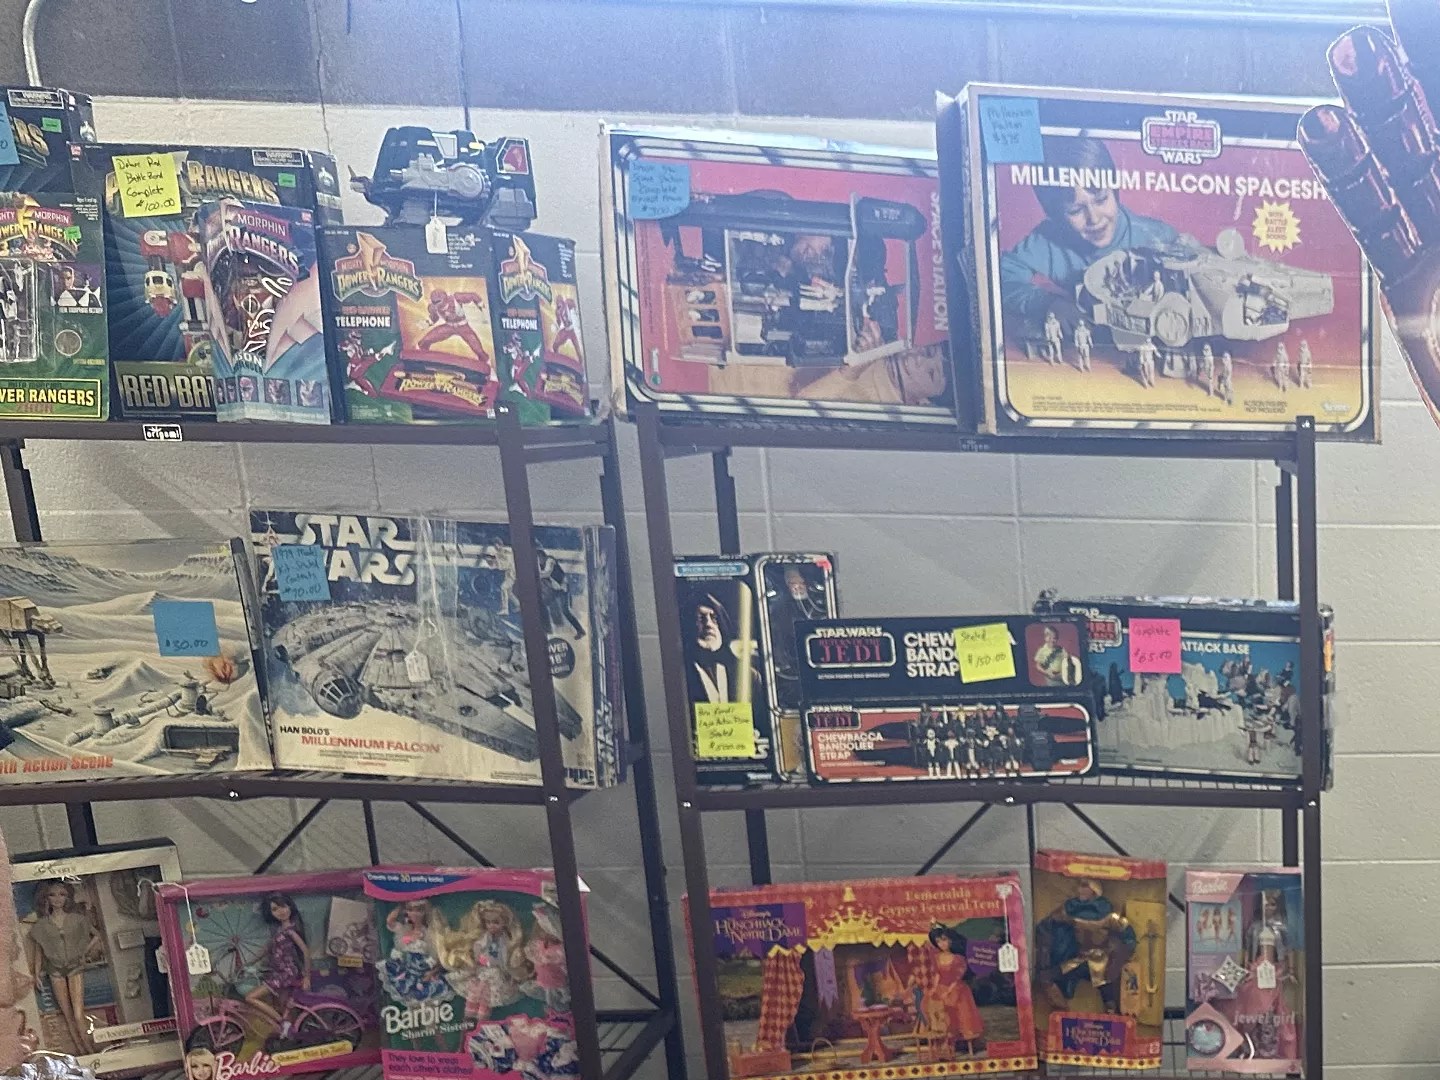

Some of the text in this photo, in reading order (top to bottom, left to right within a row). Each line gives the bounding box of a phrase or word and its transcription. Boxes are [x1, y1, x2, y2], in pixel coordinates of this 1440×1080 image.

[1164, 110, 1199, 123] STAR
[1161, 152, 1203, 165] WARS
[187, 160, 281, 204] RANGERS
[1011, 165, 1140, 191] MILLENNIUM
[1145, 171, 1230, 197] FALCON
[126, 186, 164, 198] Complete
[136, 199, 176, 212] $100.00
[237, 212, 287, 237] MORPHIN
[228, 226, 299, 270] RANGERS
[377, 269, 421, 294] RANGERS
[932, 249, 949, 331] STATION
[335, 316, 391, 328] TELEPHONE
[502, 317, 538, 331] TELEPHONE
[29, 389, 95, 407] RANGERS
[123, 375, 170, 408] RED
[295, 513, 414, 551] STAR
[323, 549, 416, 586] ARS
[816, 627, 882, 637] STAR WARS
[820, 644, 881, 663] JEDI
[1181, 643, 1250, 655] ATTACK BASE
[907, 664, 959, 678] STRAP
[280, 725, 300, 734] HAN
[818, 731, 884, 742] CHEWBACCA
[302, 735, 441, 753] MILLENNIUM FALCON
[818, 741, 875, 752] BANDOLIER
[819, 751, 851, 761] STRAP
[23, 755, 114, 773] Action Scene
[905, 889, 971, 901] Esmeralda
[879, 899, 1001, 918] Gypsy Festival Tent
[381, 1001, 454, 1034] Barbie
[1233, 1010, 1296, 1025] jewel girl
[402, 1020, 475, 1040] Sharin' Sisters
[389, 1053, 459, 1065] They love to wear
[389, 1064, 411, 1073] each
